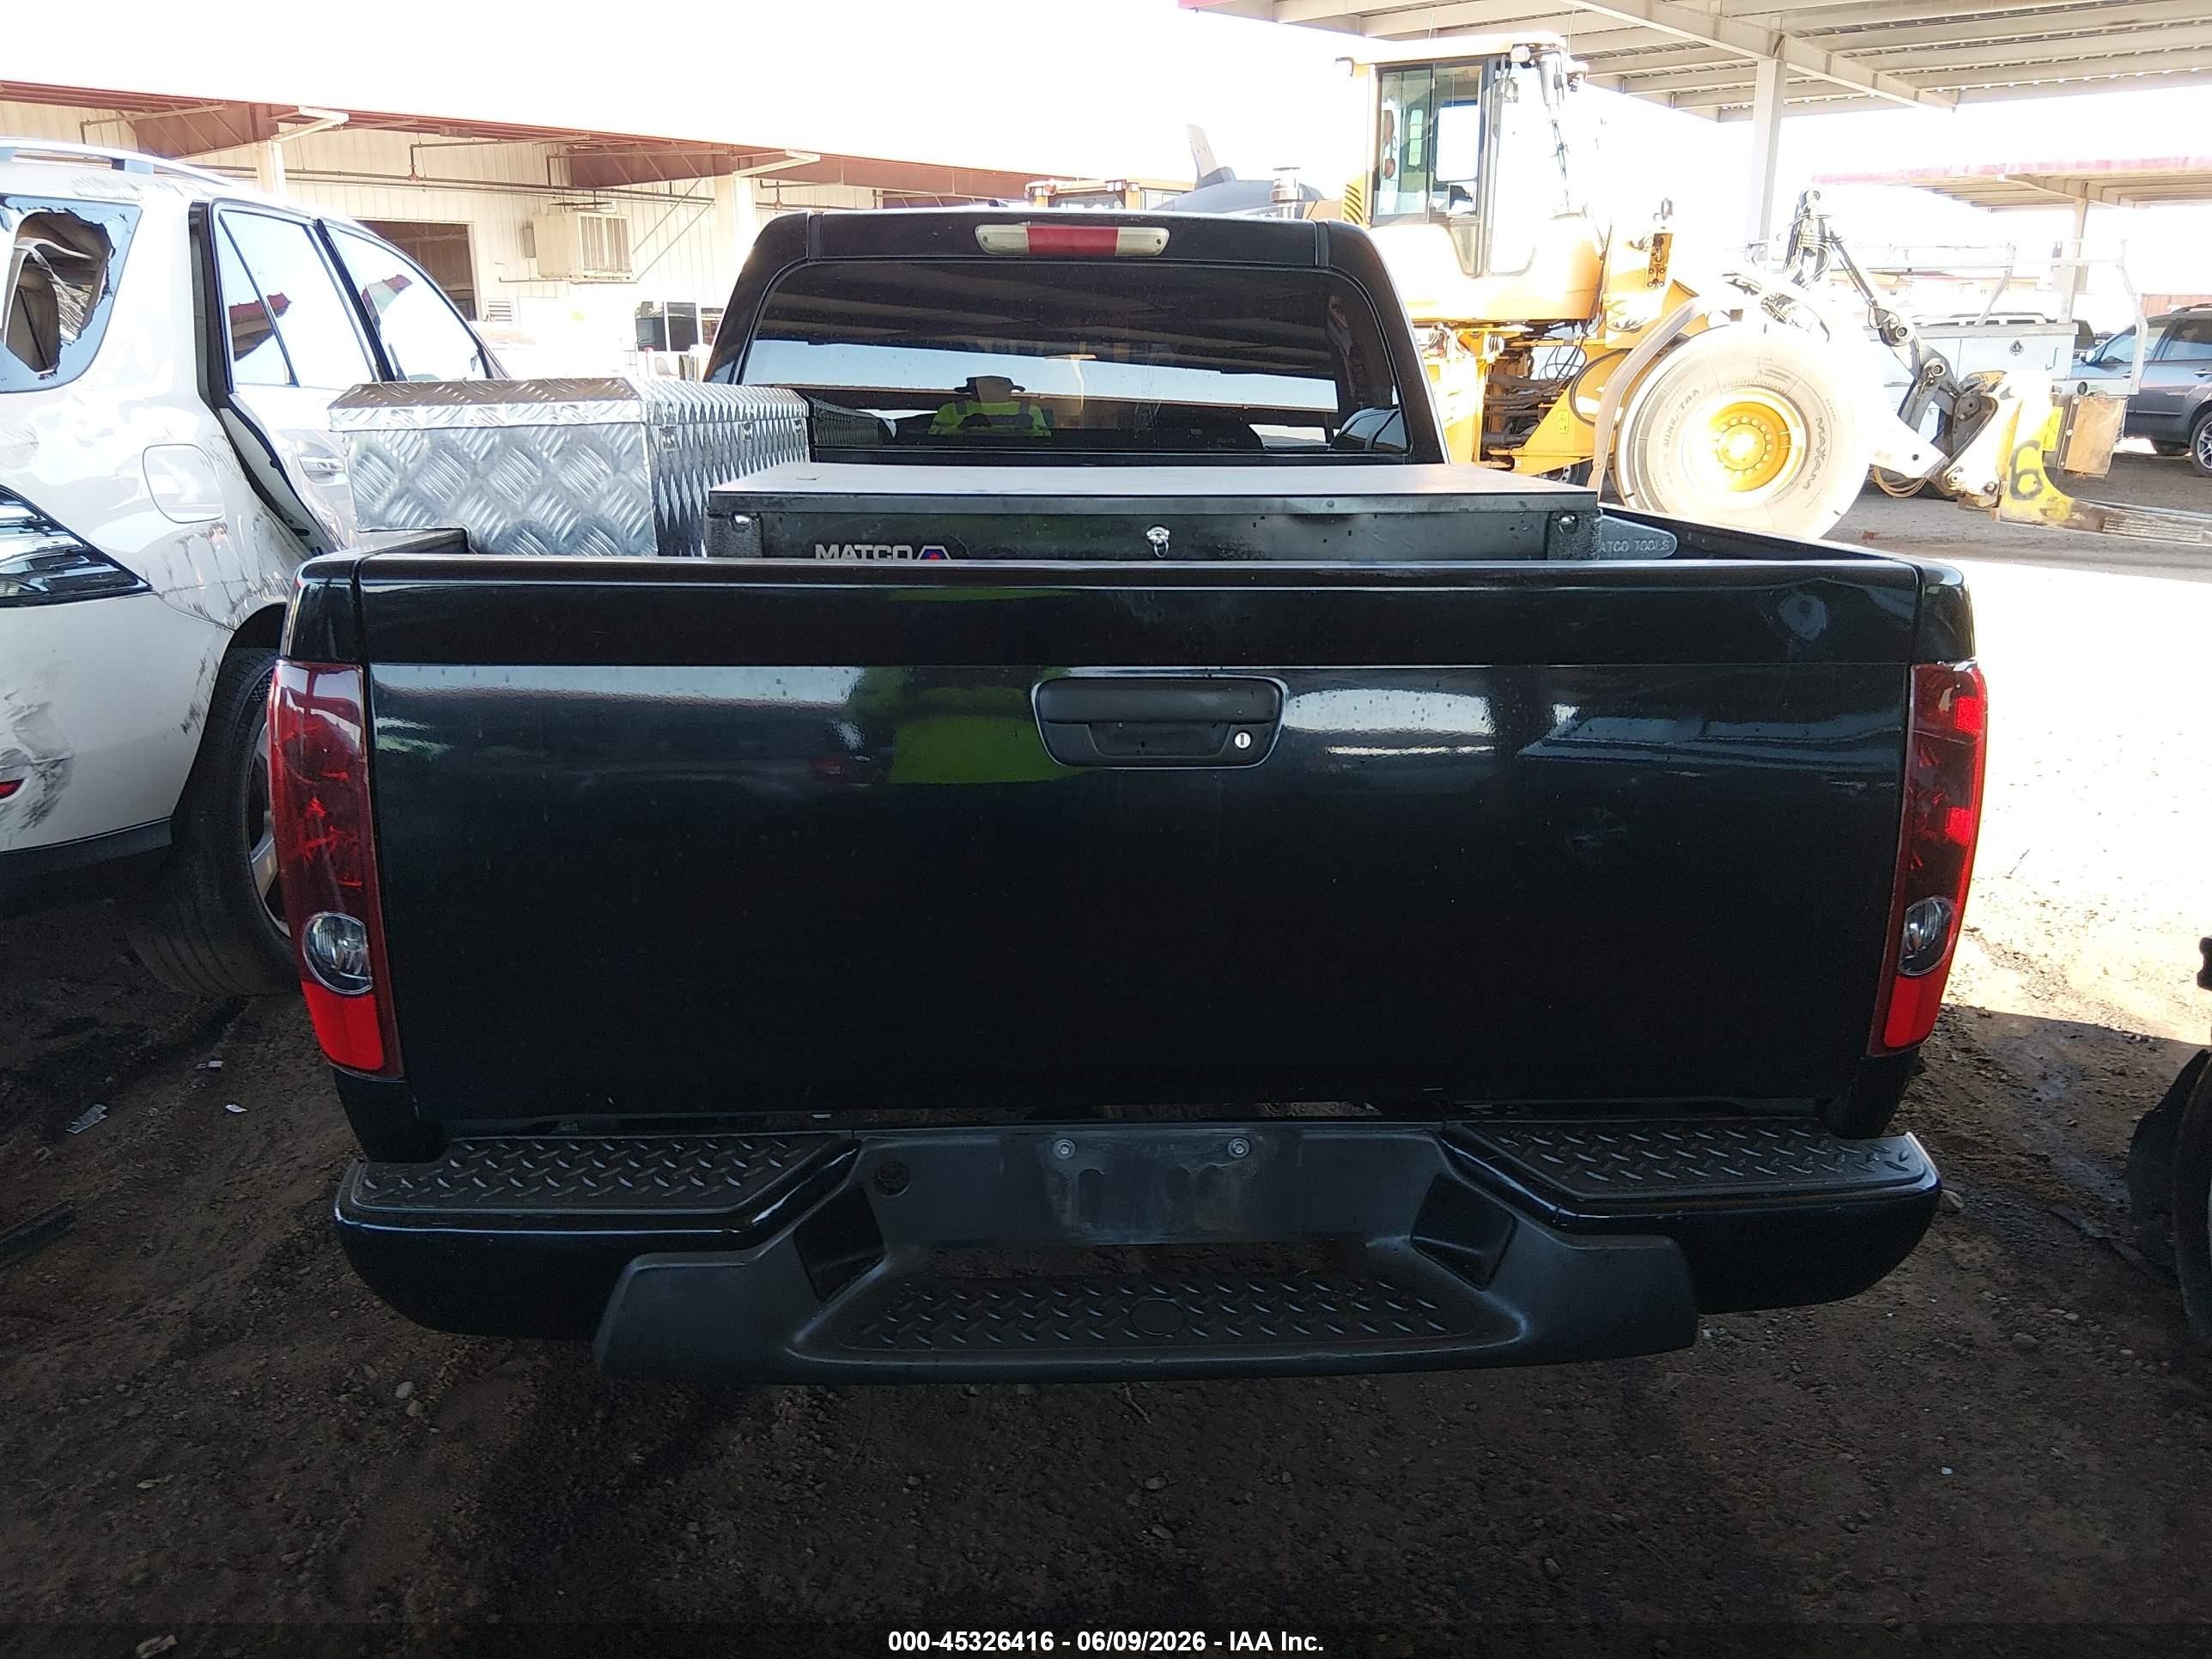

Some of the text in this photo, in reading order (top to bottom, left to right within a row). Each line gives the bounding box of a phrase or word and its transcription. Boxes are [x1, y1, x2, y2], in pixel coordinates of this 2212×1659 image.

[1802, 416, 1827, 490] MAXAM
[2009, 439, 2045, 501] 6
[814, 544, 914, 561] MATCO
[1598, 538, 1670, 553] ATCO TOOLS
